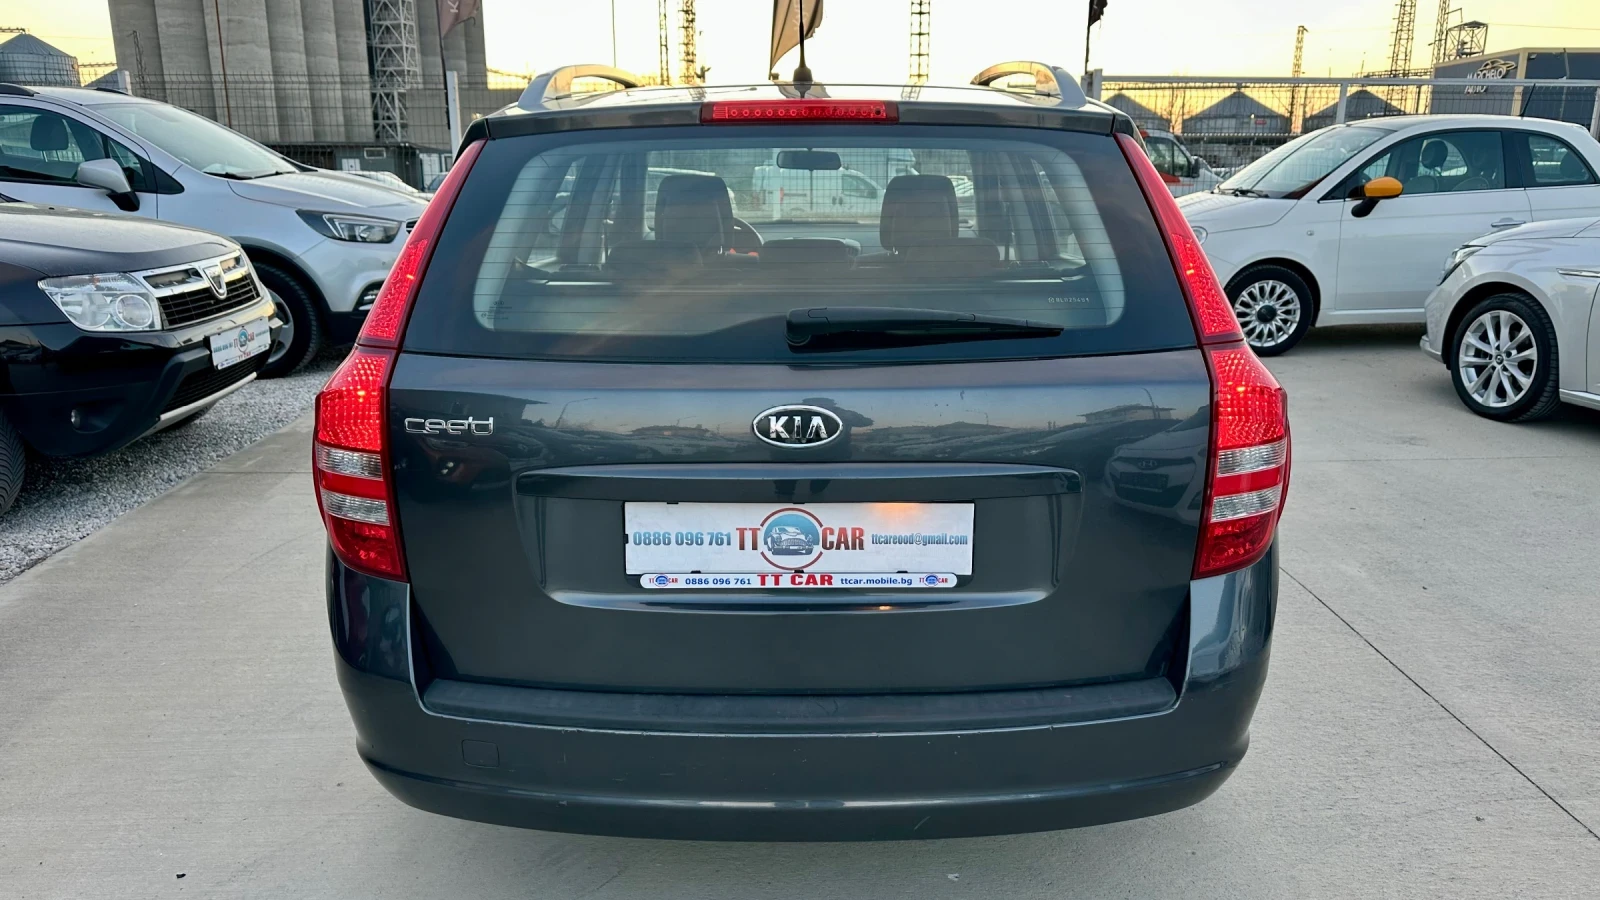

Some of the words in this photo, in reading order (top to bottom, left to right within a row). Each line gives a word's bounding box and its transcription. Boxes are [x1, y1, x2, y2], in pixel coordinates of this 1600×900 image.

[768, 415, 828, 440] KIA
[632, 531, 672, 546] 0886
[674, 531, 705, 546] 096
[707, 531, 732, 546] 761
[735, 527, 761, 551] TT
[821, 527, 865, 551] CAR
[871, 532, 968, 547] ttcareood@gmail.com
[685, 577, 710, 585] 0886
[712, 577, 731, 585] 096
[734, 577, 752, 585] 761
[757, 574, 783, 587] TT
[790, 574, 833, 587] CAR
[840, 577, 912, 586] ttcar.mobile.bg
